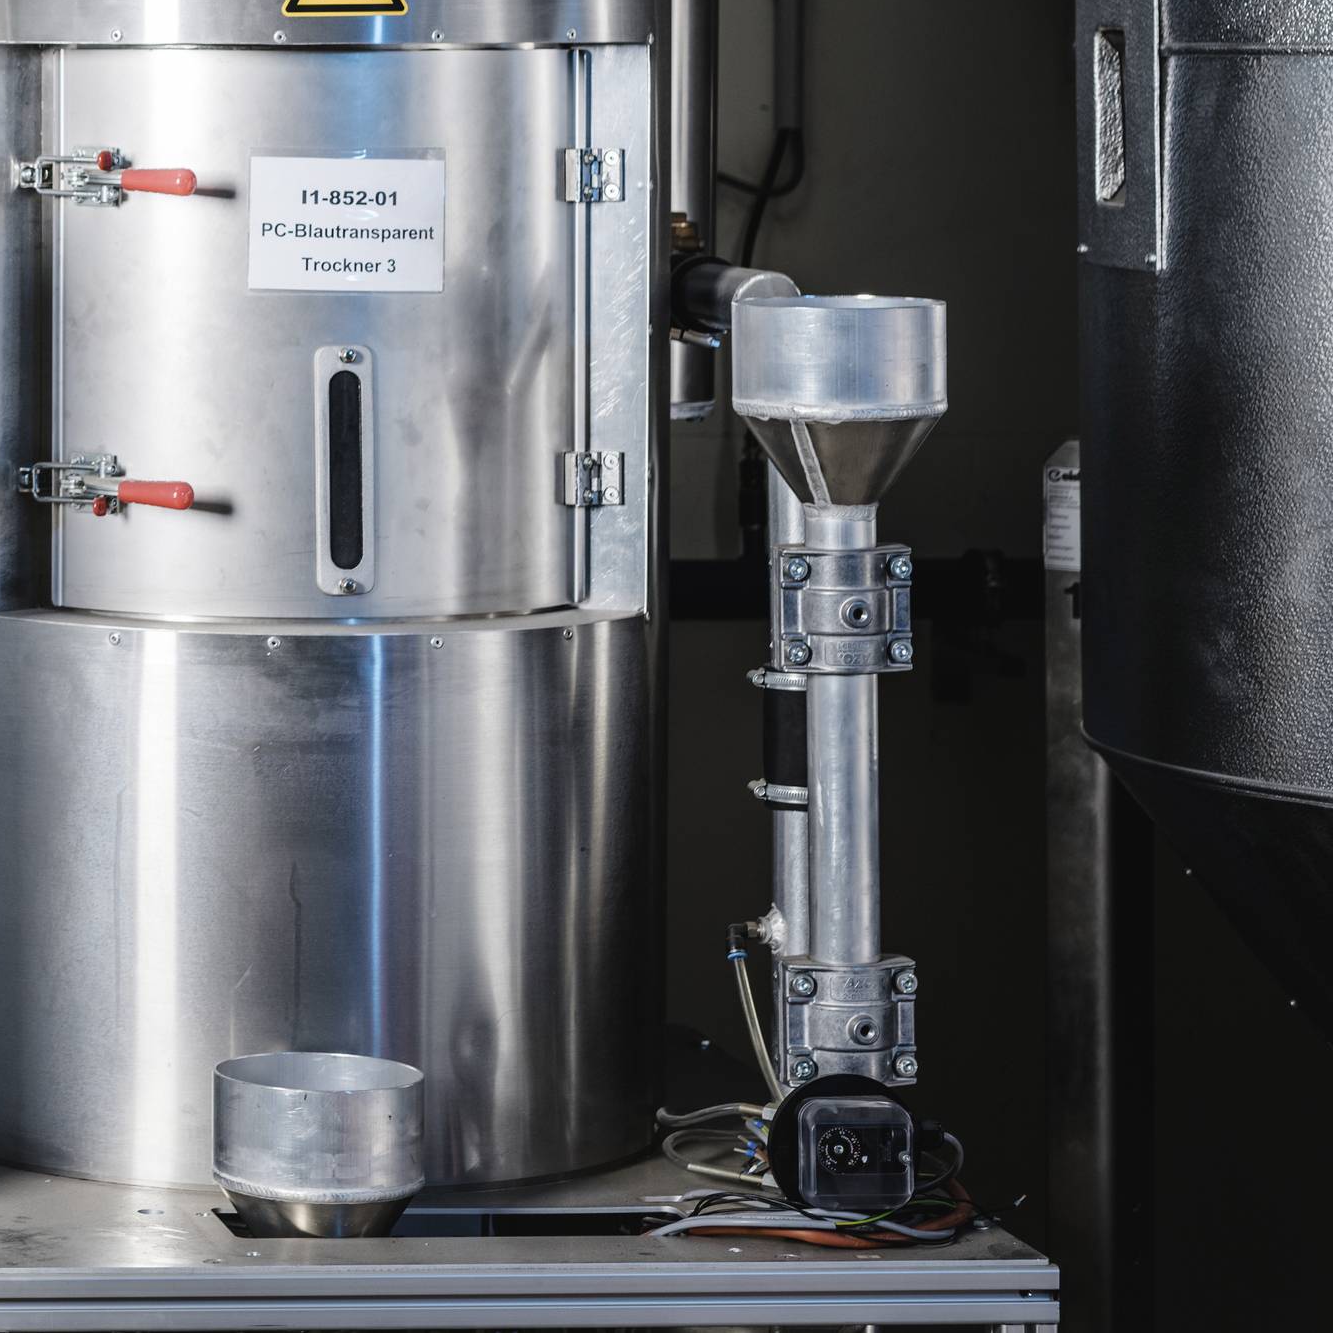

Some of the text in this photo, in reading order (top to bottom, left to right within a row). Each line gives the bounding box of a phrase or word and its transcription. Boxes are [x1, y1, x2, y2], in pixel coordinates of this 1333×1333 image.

[261, 222, 434, 242] PC-Blautransparent
[302, 257, 396, 273] Trockner 3
